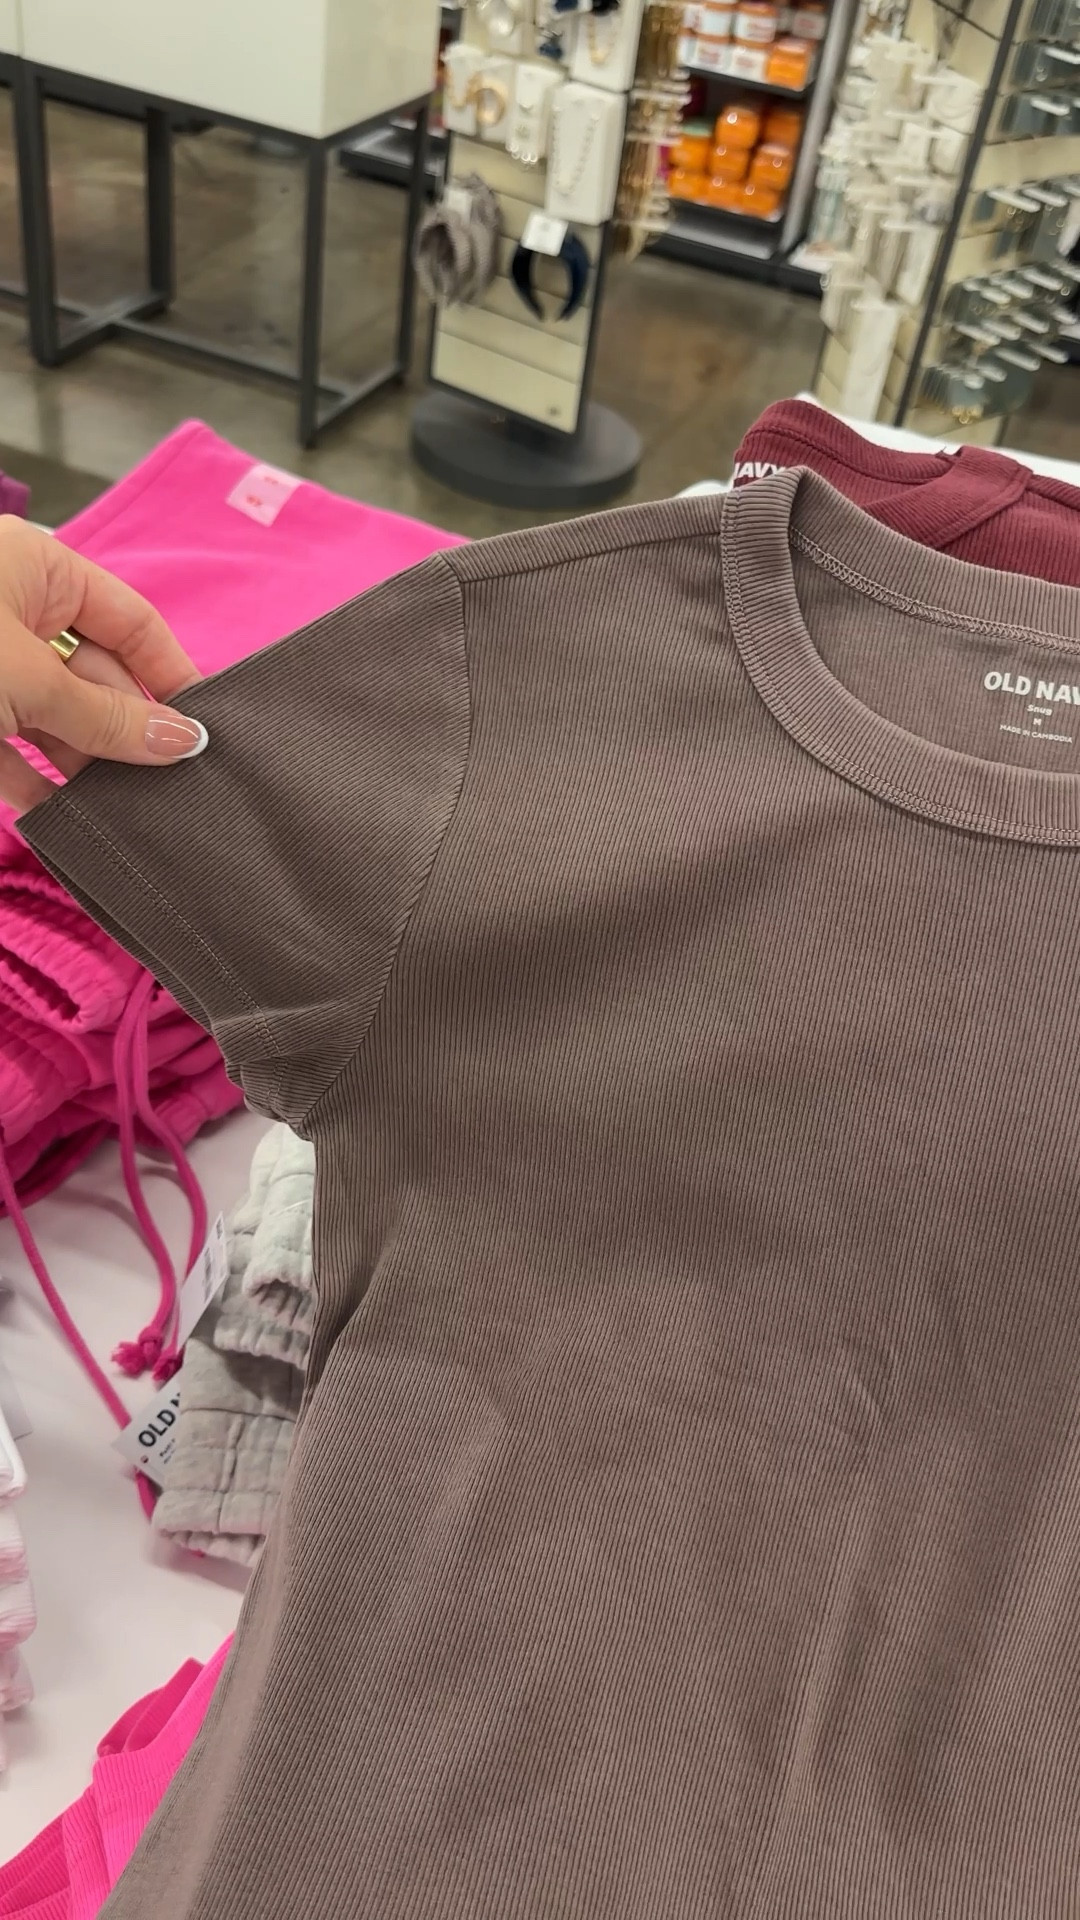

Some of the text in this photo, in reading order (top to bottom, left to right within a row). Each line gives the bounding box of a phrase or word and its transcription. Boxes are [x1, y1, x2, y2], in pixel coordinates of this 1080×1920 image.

[734, 462, 786, 478] AVY
[984, 671, 1031, 696] OLD
[1027, 704, 1053, 716] Snug
[1033, 718, 1042, 726] M
[1000, 724, 1073, 743] MADE IN CAMBODIA
[138, 1409, 176, 1447] OLD
